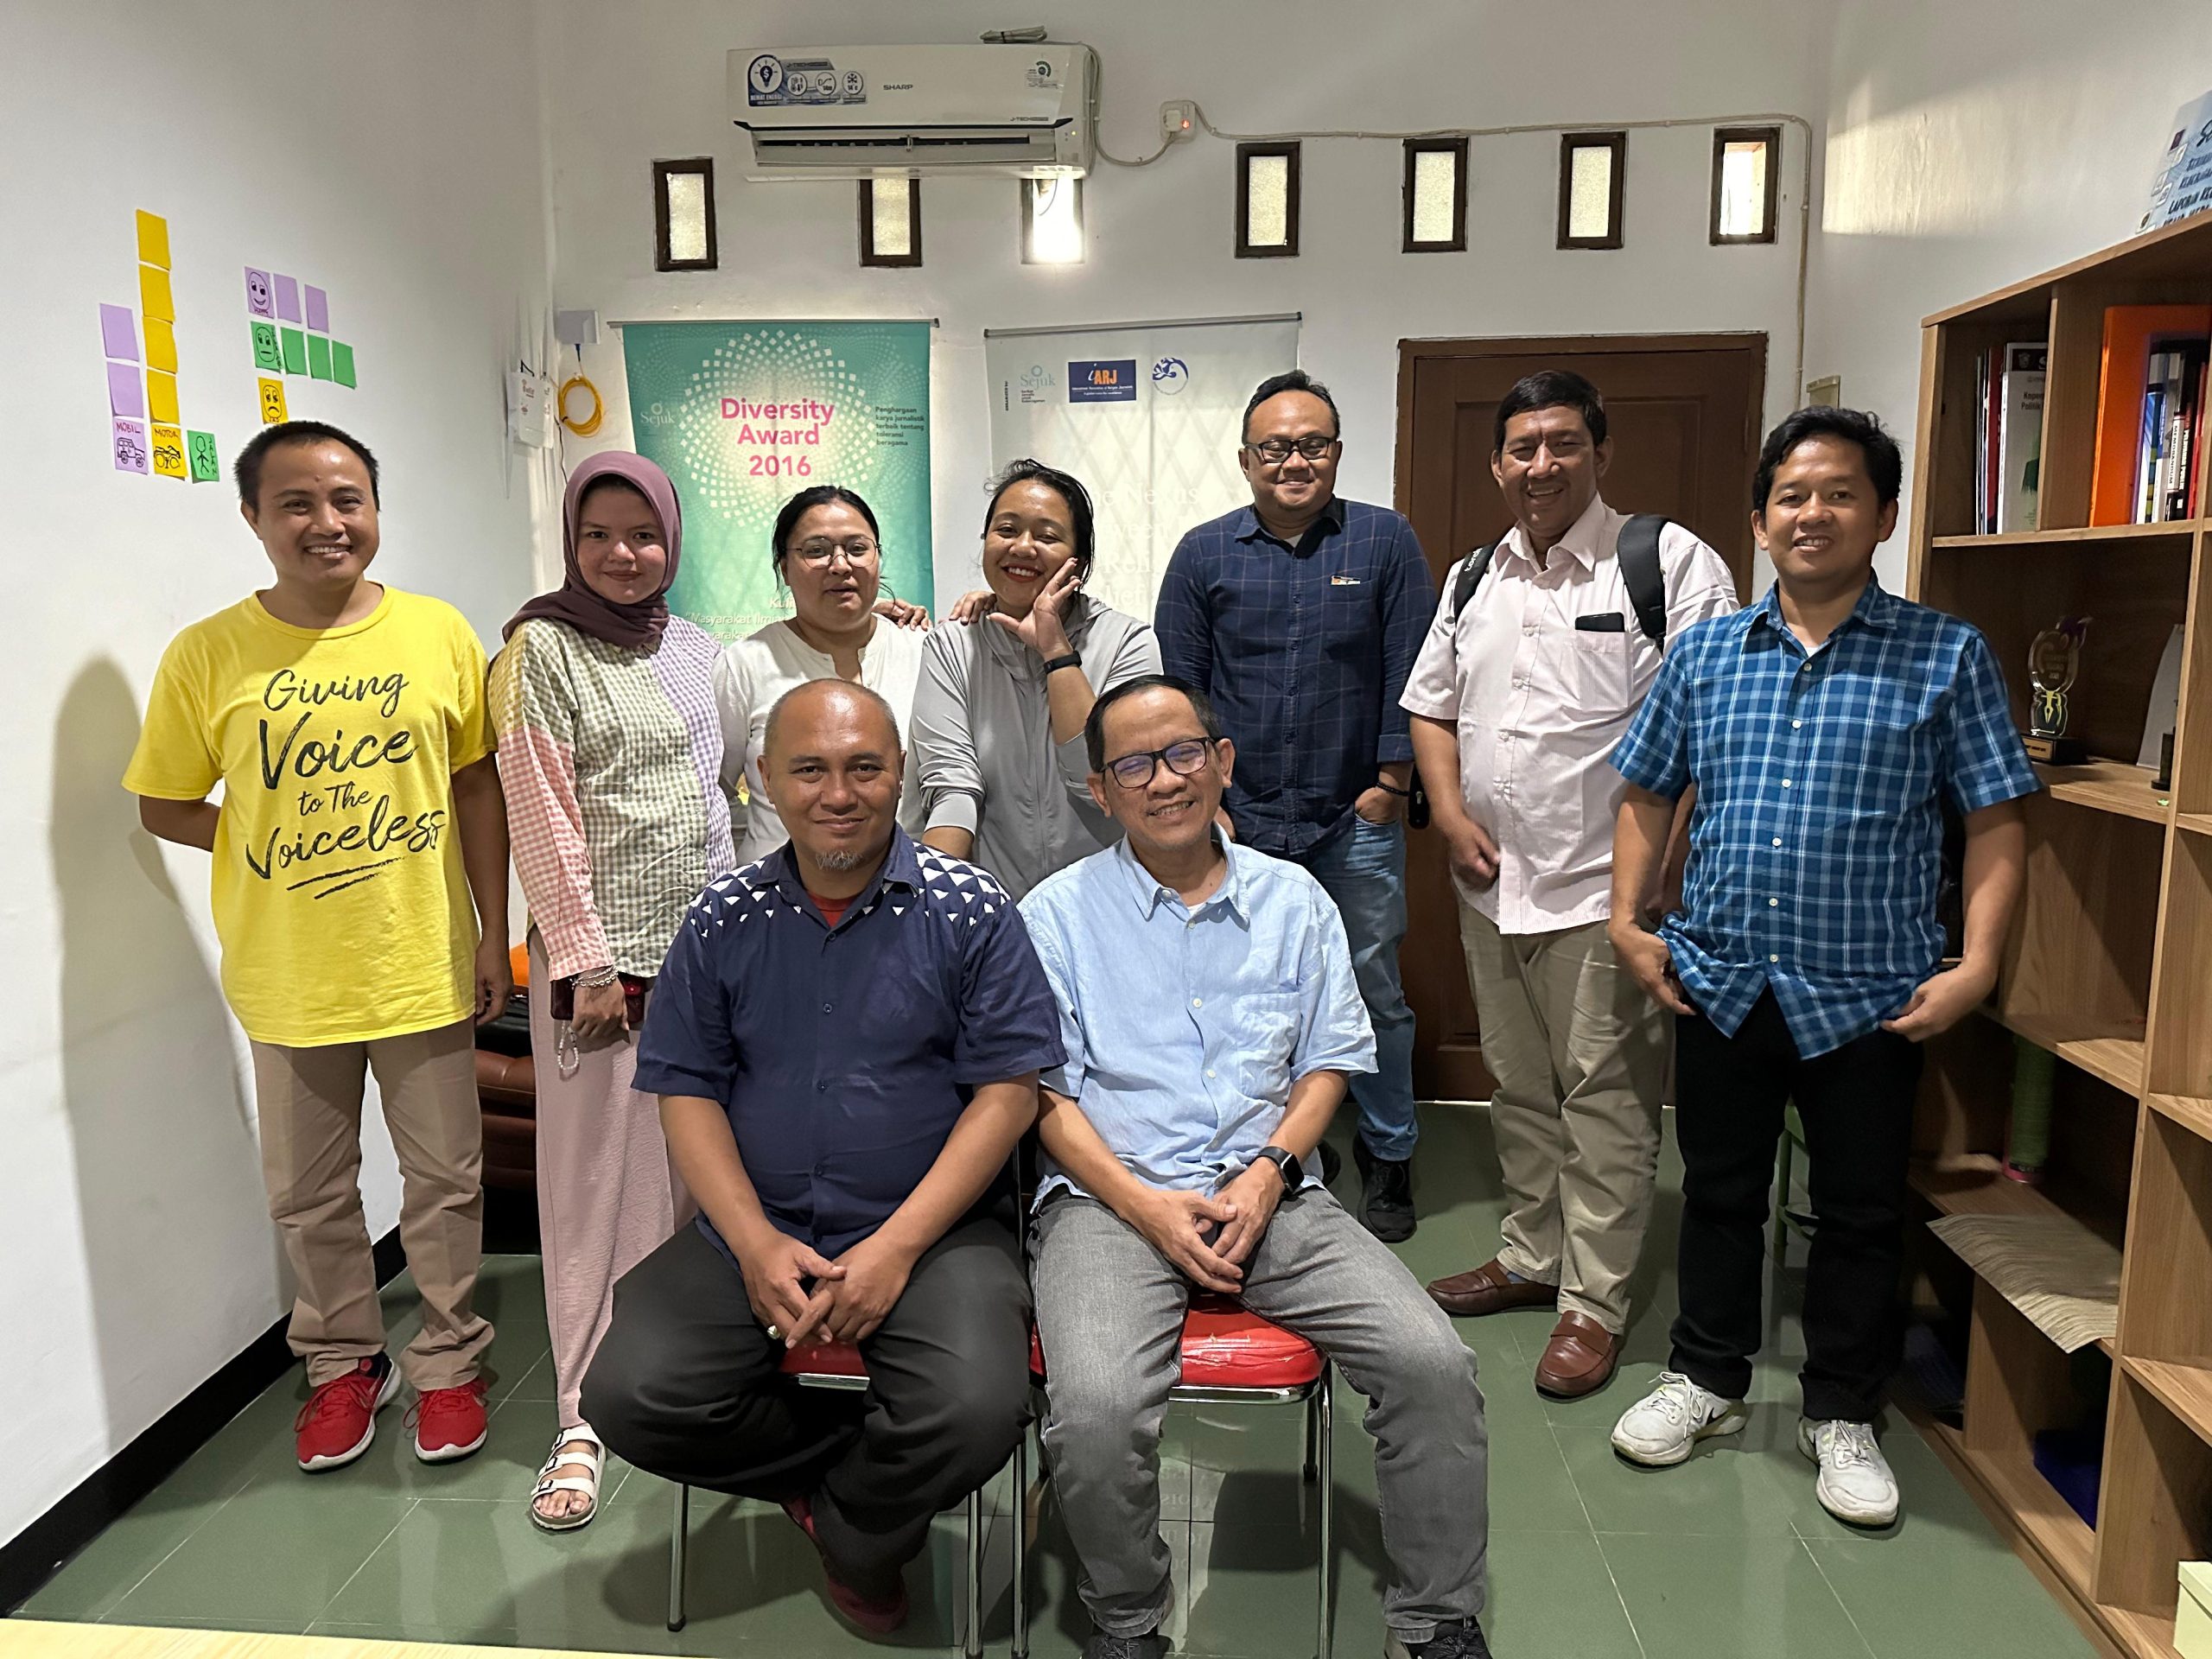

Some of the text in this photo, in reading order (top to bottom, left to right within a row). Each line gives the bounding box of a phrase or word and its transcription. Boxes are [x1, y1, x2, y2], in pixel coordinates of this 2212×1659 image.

[1020, 373, 1056, 390] Sejuk
[640, 410, 676, 427] Sejuk
[721, 397, 836, 426] Diversity
[116, 422, 141, 434] MOBIL
[154, 428, 179, 437] MOTOR
[737, 423, 820, 445] Award
[749, 454, 811, 476] 2016
[2168, 425, 2178, 485] MEMORANDUM
[264, 669, 410, 718] Giving
[259, 711, 420, 790] Voice
[297, 780, 374, 817] to The
[245, 794, 447, 880] Voiceless
